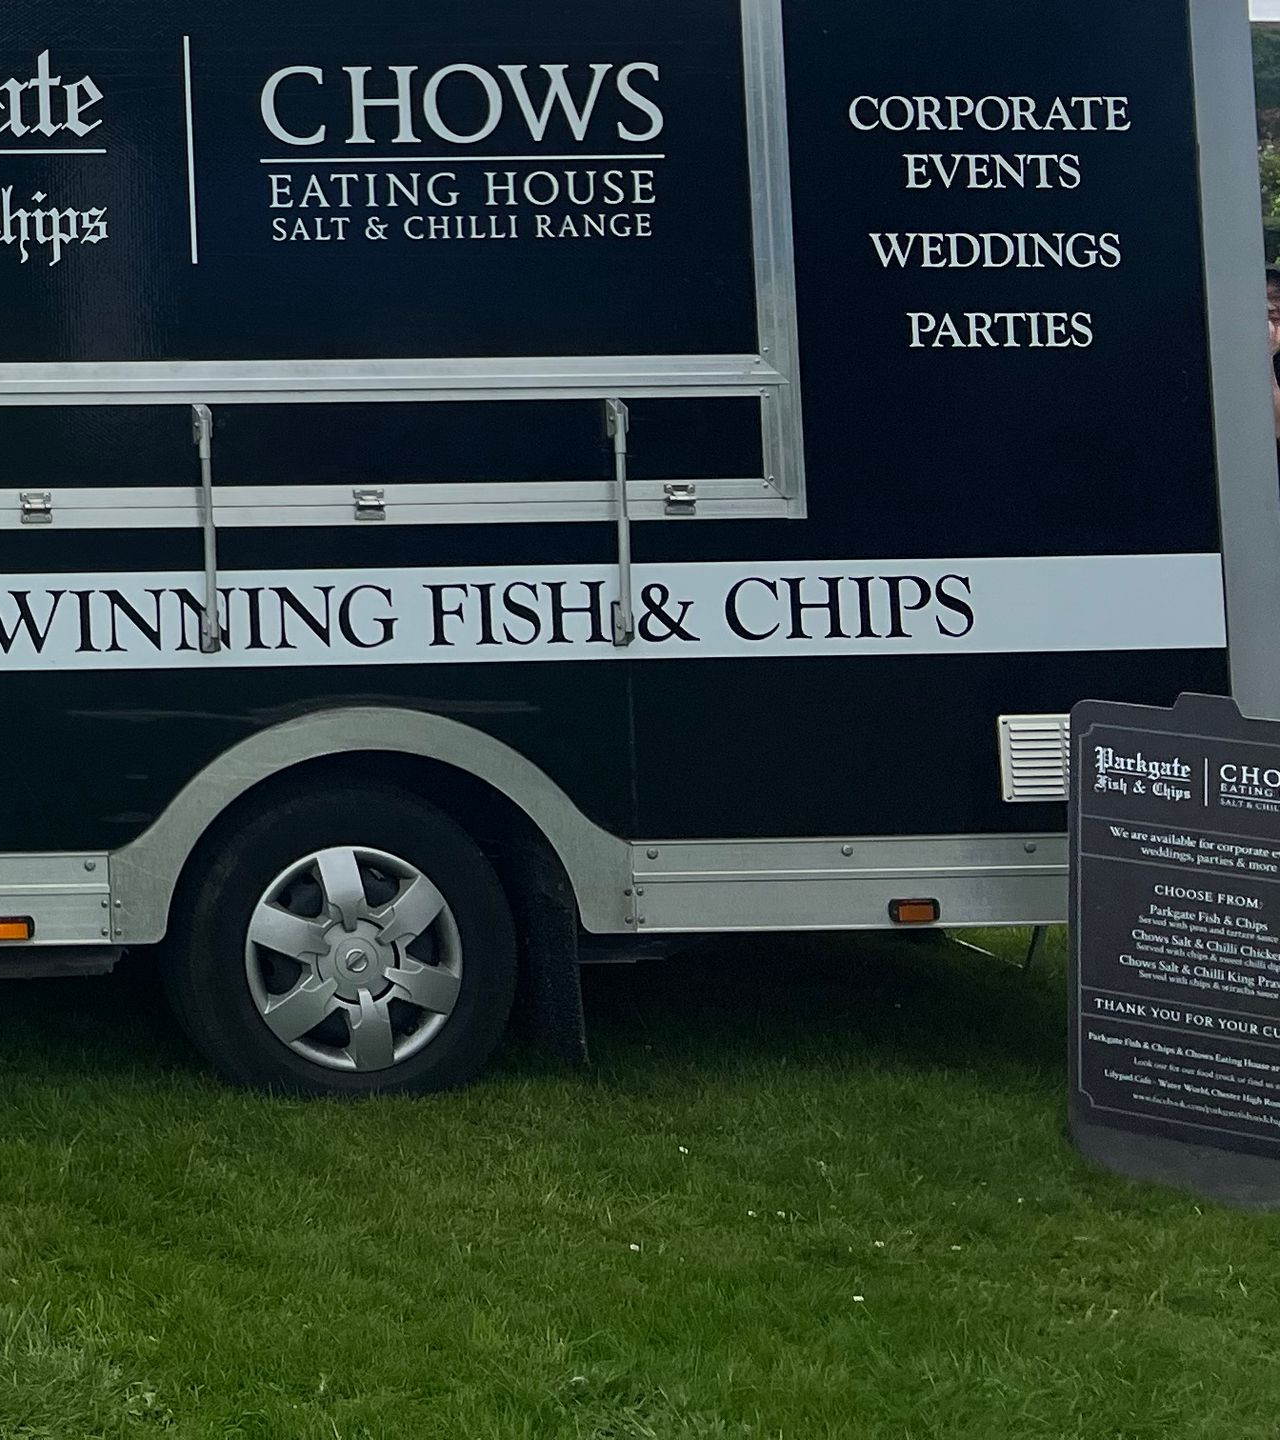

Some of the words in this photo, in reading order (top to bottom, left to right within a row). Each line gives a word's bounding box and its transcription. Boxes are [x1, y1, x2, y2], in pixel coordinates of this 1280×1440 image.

[260, 62, 665, 145] CHOWS
[848, 95, 1131, 131] CORPORATE
[903, 153, 1081, 189] EVENTS
[268, 173, 460, 208] EATING
[484, 170, 656, 206] HOUSE
[272, 217, 351, 242] SALT
[365, 217, 389, 241] &
[403, 215, 518, 240] CHILLI
[535, 213, 653, 238] RANGE
[869, 232, 1121, 268] WEDDINGS
[906, 312, 1093, 347] PARTIES
[423, 580, 613, 647] FISH
[639, 582, 700, 643] &
[724, 573, 975, 640] CHIPS
[1094, 746, 1192, 781] Parkgate
[1094, 774, 1128, 795] Fish
[1133, 780, 1147, 794] &
[1152, 782, 1192, 802] Chips
[1220, 783, 1274, 797] EATING
[1220, 798, 1244, 808] SALT
[1110, 826, 1128, 837] We
[1130, 831, 1148, 841] are
[1150, 833, 1197, 848] available
[1199, 838, 1215, 850] for
[1216, 843, 1269, 857] corporate
[1197, 853, 1234, 868] parties
[1236, 858, 1246, 868] &
[1248, 861, 1277, 872] more
[1154, 884, 1213, 902] CHOOSE
[1150, 904, 1196, 921] Parkgate
[1198, 912, 1221, 925] Fish
[1223, 915, 1233, 926] &
[1235, 917, 1268, 932] Chips
[1131, 929, 1169, 944] Chows
[1171, 935, 1191, 948] Salt
[1194, 939, 1204, 949] &
[1206, 940, 1238, 954] Chilli
[1119, 954, 1157, 970] Chows
[1158, 960, 1179, 974] Salt
[1181, 964, 1191, 975] &
[1193, 966, 1225, 980] Chilli
[1227, 971, 1255, 987] King
[1094, 997, 1147, 1016] THANK
[1150, 1007, 1181, 1022] YOU
[1185, 1013, 1214, 1027] FOR
[1218, 1018, 1258, 1035] YOUR
